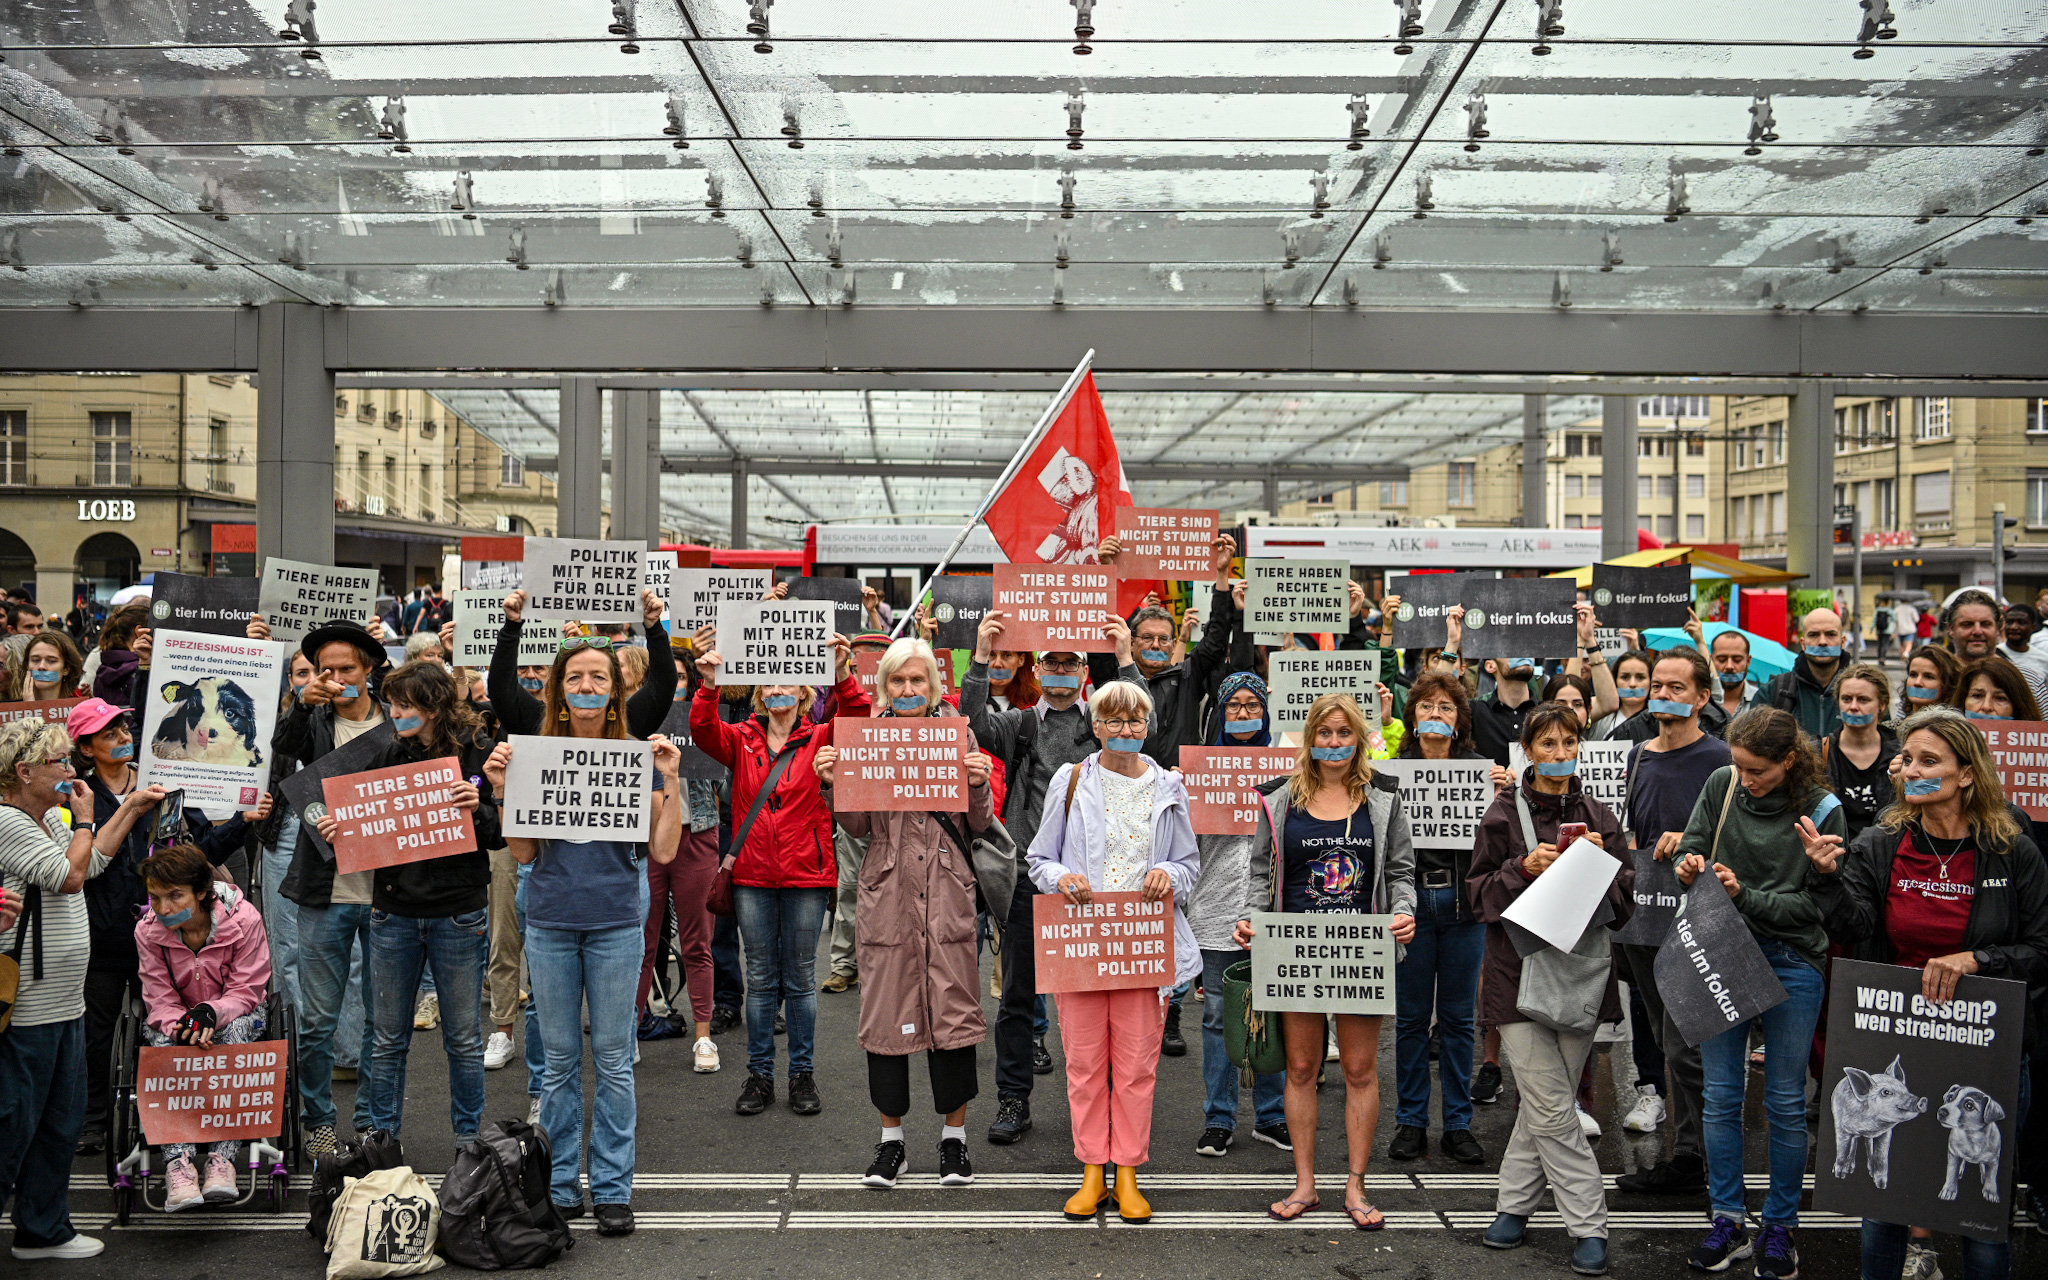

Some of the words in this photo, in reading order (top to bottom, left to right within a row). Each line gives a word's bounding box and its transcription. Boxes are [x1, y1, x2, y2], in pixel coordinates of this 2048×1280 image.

[78, 500, 136, 521] LOEB
[366, 495, 384, 515] LOEB
[1138, 516, 1176, 527] TIERE
[1181, 517, 1211, 528] SIND
[882, 534, 898, 542] UNS
[1120, 530, 1158, 541] NICHT
[1163, 531, 1211, 542] STUMM
[1136, 545, 1162, 555] NUR
[1167, 546, 1180, 556] IN
[1185, 547, 1210, 557] DER
[1387, 538, 1421, 551] AEK
[1500, 539, 1535, 552] AEK
[571, 549, 638, 564] POLITIK
[553, 565, 584, 578] MIT
[592, 567, 637, 579] HERZ
[1159, 560, 1209, 571] POLITIK
[277, 569, 319, 584] TIERE
[325, 576, 370, 589] HABEN
[1256, 568, 1293, 577] TIERE
[1299, 568, 1342, 578] HABEN
[709, 578, 764, 588] POLITIK
[1020, 574, 1065, 586] TIERE
[1072, 575, 1108, 586] SIND
[554, 579, 586, 595] FÜR
[595, 582, 636, 595] ALLE
[1277, 583, 1328, 593] RECHTE
[299, 589, 353, 604] RECHTE
[694, 592, 720, 602] MIT
[1000, 592, 1045, 604] NICHT
[1050, 592, 1107, 605] STUMM
[1263, 597, 1296, 607] GEBT
[1302, 598, 1342, 607] IHNEN
[1596, 591, 1610, 603] tif
[1616, 594, 1636, 604] tier
[1639, 593, 1654, 603] im
[1656, 592, 1688, 604] fokus
[532, 597, 635, 612] LEBEWESEN
[834, 602, 859, 611] fokus
[155, 604, 168, 615] tif
[175, 607, 197, 619] tier
[201, 608, 216, 619] im
[220, 608, 257, 620] fokus
[281, 603, 319, 616] GEBT
[325, 607, 367, 620] IHNEN
[760, 610, 826, 624] POLITIK
[938, 607, 951, 619] tif
[959, 608, 980, 619] tier
[1019, 609, 1050, 621] NUR
[1056, 610, 1071, 622] IN
[1077, 610, 1107, 622] DER
[1255, 612, 1284, 621] EINE
[1289, 612, 1342, 622] STIMME
[1398, 606, 1411, 618] tif
[1418, 606, 1444, 617] tier
[269, 615, 301, 630] EINE
[1468, 613, 1482, 625] tif
[1490, 613, 1513, 625] tier
[1516, 613, 1534, 625] im
[1535, 612, 1573, 625] fokus
[744, 628, 774, 640] MIT
[782, 628, 826, 640] HERZ
[1047, 627, 1108, 640] POLITIK
[165, 639, 244, 654] SPEZIESISMUS
[247, 648, 264, 656] IST
[746, 641, 778, 657] FÜR
[786, 645, 825, 657] ALLE
[250, 661, 272, 669] liebst
[725, 661, 826, 675] LEBEWESEN
[1279, 661, 1319, 671] TIERE
[1326, 660, 1372, 671] HABEN
[208, 668, 241, 676] anderen
[1302, 678, 1357, 687] RECHTE
[862, 729, 911, 742] TIERE
[918, 728, 957, 741] SIND
[563, 750, 643, 768] POLITIK
[840, 748, 889, 761] NICHT
[896, 748, 957, 761] STUMM
[1206, 757, 1252, 769] TIERE
[1258, 757, 1294, 769] SIND
[159, 771, 199, 780] Zugehörigkeit
[184, 766, 228, 776] Diskriminierung
[862, 767, 895, 780] NUR
[902, 767, 918, 779] IN
[926, 767, 958, 779] DER
[1414, 770, 1484, 783] POLITIK
[355, 776, 408, 798] TIERE
[413, 768, 454, 787] SIND
[541, 770, 579, 785] MIT
[588, 771, 642, 788] HERZ
[1185, 774, 1232, 786] NICHT
[543, 787, 581, 806] FÜR
[591, 792, 640, 808] ALLE
[894, 785, 959, 798] POLITIK
[1205, 792, 1236, 804] NUR
[1243, 792, 1258, 804] IN
[1398, 788, 1429, 801] MIT
[1438, 789, 1484, 801] HERZ
[335, 800, 387, 821] NICHT
[1442, 806, 1484, 819] ALLE
[361, 818, 397, 837] NUR
[403, 813, 420, 829] IN
[428, 807, 462, 824] DER
[516, 809, 638, 828] LEBEWESEN
[397, 825, 465, 850] POLITIK
[1302, 838, 1325, 847] NOT
[1346, 838, 1372, 847] SAME
[1657, 892, 1677, 907] im
[1064, 903, 1116, 918] TIERE
[1123, 901, 1164, 916] SIND
[1042, 924, 1094, 939] NICHT
[1100, 921, 1164, 936] STUMM
[1266, 925, 1317, 938] TIERE
[1326, 926, 1383, 939] HABEN
[1065, 943, 1099, 958] NUR
[1107, 942, 1124, 956] IN
[1132, 940, 1165, 955] DER
[1296, 945, 1364, 958] RECHTE
[1098, 959, 1165, 976] POLITIK
[1278, 965, 1322, 978] GEBT
[1331, 966, 1384, 979] IHNEN
[1677, 919, 1697, 948] tier
[1690, 948, 1711, 974] im
[1704, 973, 1739, 1022] fokus
[1267, 985, 1306, 997] EINE
[1313, 985, 1385, 999] STIMME
[1856, 986, 1904, 1013] wen
[1911, 992, 1997, 1025] essen?
[1854, 1013, 1891, 1032] wen
[1895, 1017, 1996, 1047] streicheln?
[173, 1056, 227, 1071] TIERE
[235, 1052, 276, 1068] SIND
[145, 1077, 202, 1092] NICHT
[208, 1072, 275, 1089] STUMM
[168, 1096, 205, 1110] NUR
[213, 1094, 231, 1109] IN
[239, 1091, 273, 1107] DER
[201, 1110, 273, 1128] POLITIK
